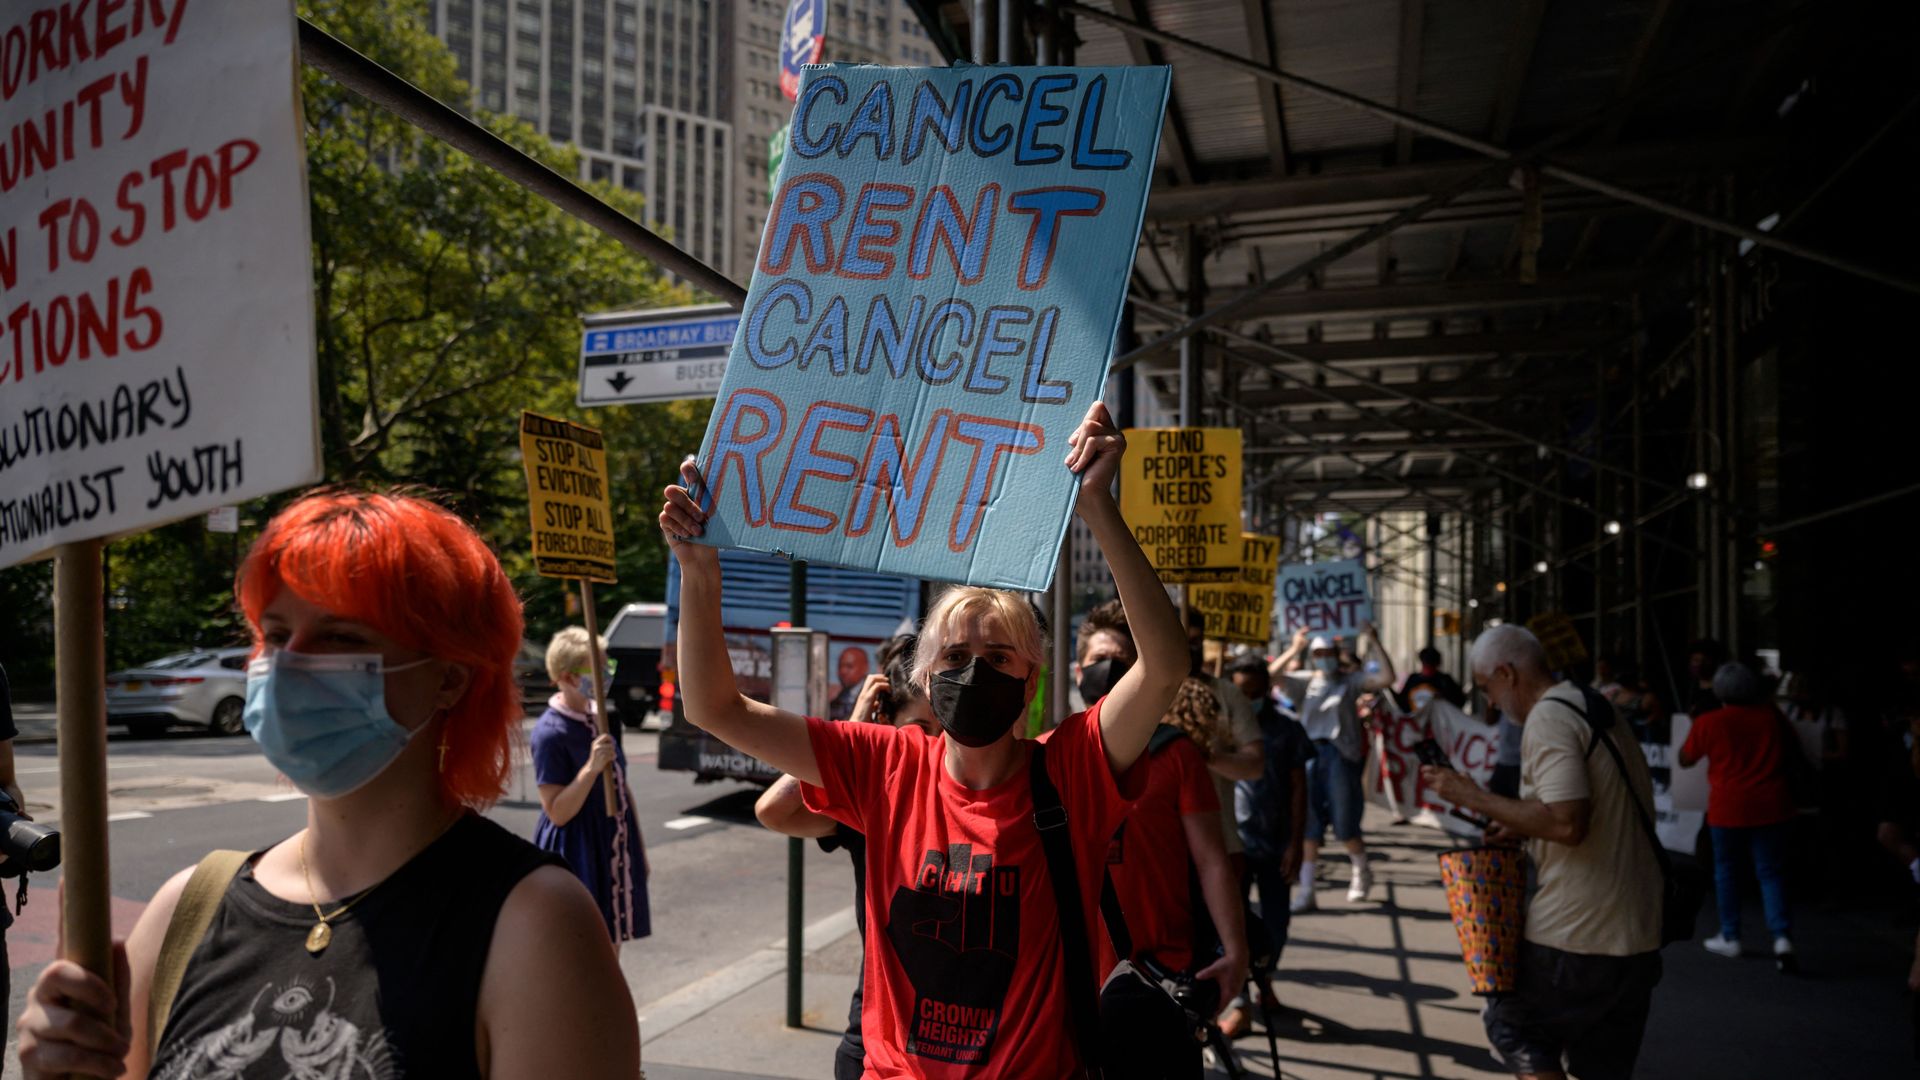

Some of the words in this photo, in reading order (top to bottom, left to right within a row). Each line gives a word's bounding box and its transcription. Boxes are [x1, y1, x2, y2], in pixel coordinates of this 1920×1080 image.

[790, 73, 1133, 171] CANCEL
[39, 198, 100, 273] TO
[110, 138, 260, 248] STOP
[759, 172, 1106, 291] RENT
[614, 328, 699, 350] BROADWAY
[745, 278, 1072, 404] CANCEL
[677, 362, 726, 381] BUSES
[0, 365, 191, 471] LUTIONARY
[536, 438, 574, 467] STOP
[578, 446, 597, 473] ALL
[1156, 430, 1204, 453] FUND
[147, 437, 243, 510] YOUTH
[699, 387, 1044, 552] RENT
[1143, 455, 1226, 480] PEOPLE'S
[537, 465, 603, 501] EVICTIONS
[1152, 482, 1213, 505] NEEDS
[545, 501, 582, 530] STOP
[587, 506, 607, 536] ALL
[1160, 509, 1202, 524] NOT
[1135, 524, 1228, 545] CORPORATE
[1156, 546, 1206, 567] GREED
[1195, 588, 1264, 614] HOUSING
[1283, 573, 1364, 601] CANCEL
[1203, 611, 1223, 633] OR
[1284, 600, 1366, 634] RENT
[700, 753, 753, 774] WATCH
[920, 998, 995, 1030] CROWN
[918, 1020, 990, 1048] HEIGHTS
